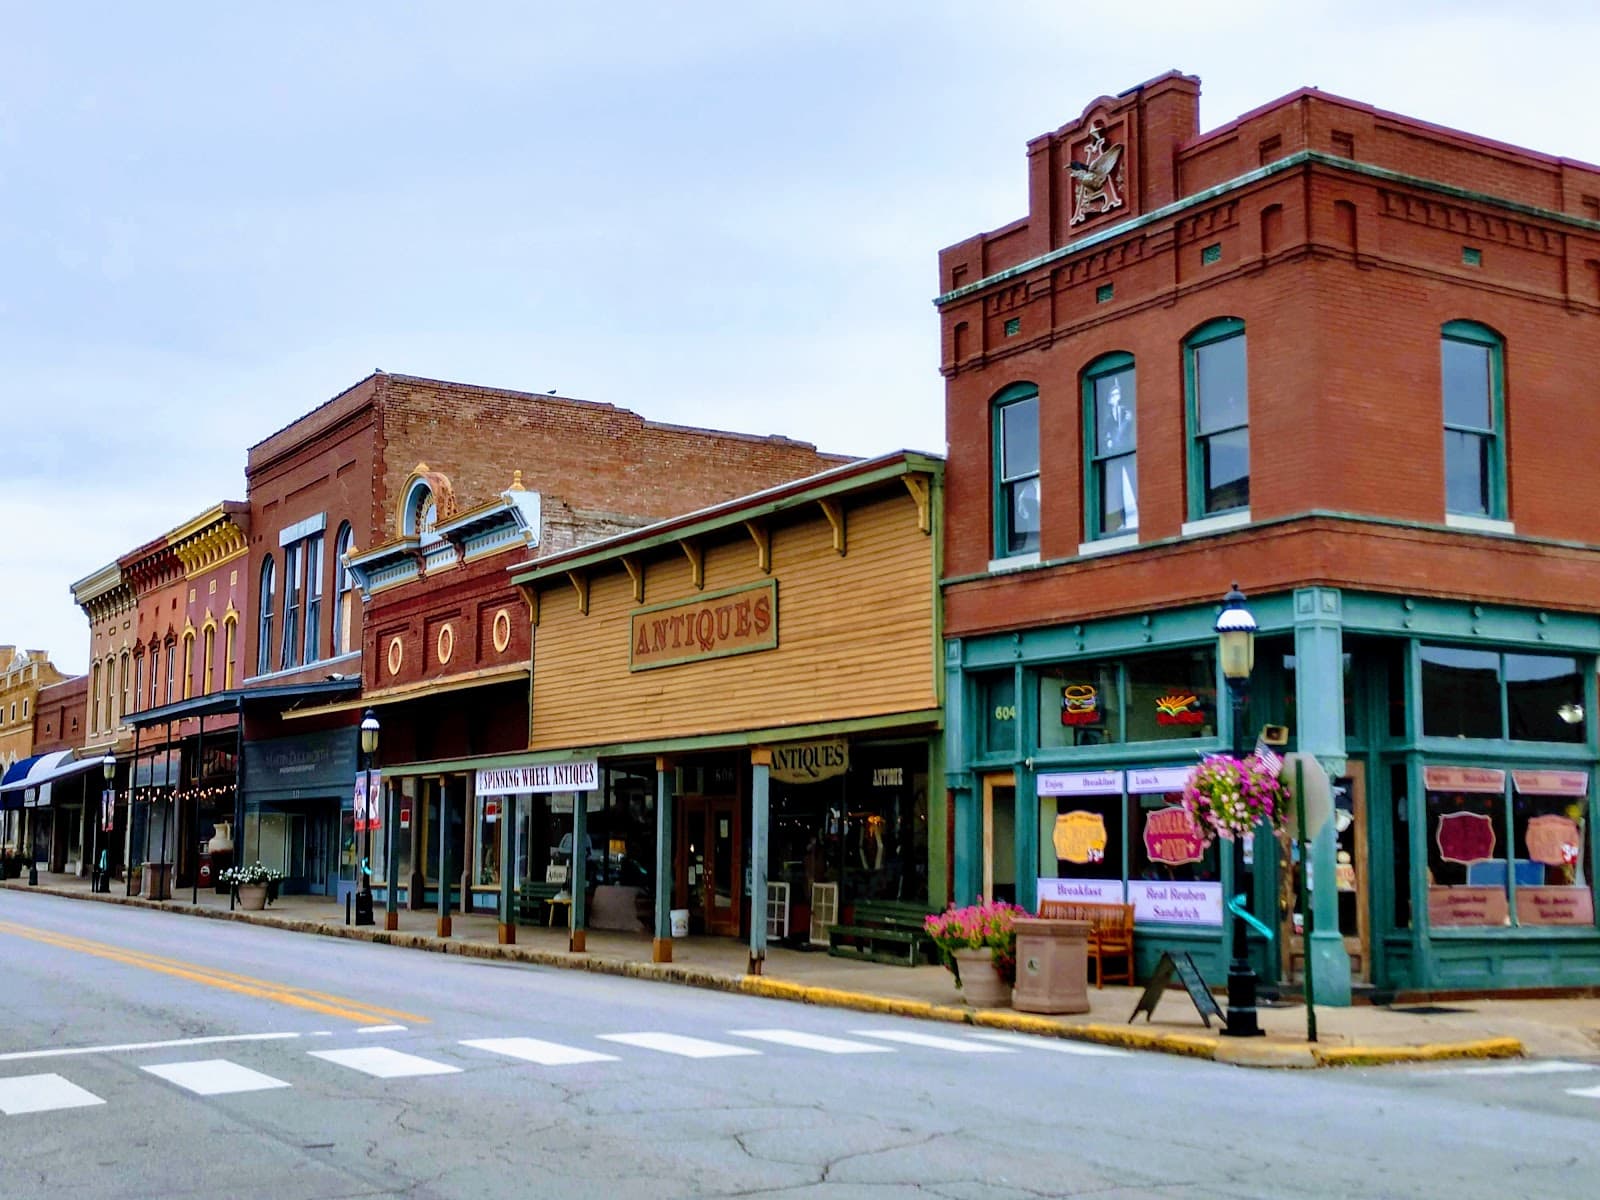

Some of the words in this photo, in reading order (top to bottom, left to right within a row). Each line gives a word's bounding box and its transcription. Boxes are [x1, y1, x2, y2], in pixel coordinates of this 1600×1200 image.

[635, 595, 772, 656] ANTIQUES
[995, 705, 1016, 721] 604
[770, 744, 844, 778] ANTIQUES
[484, 767, 519, 790] SPINNING
[521, 765, 551, 787] WHEEL
[553, 763, 594, 786] ANTIQUES
[1057, 882, 1103, 897] Breakfast
[1146, 886, 1168, 901] Real
[1152, 904, 1200, 919] Sandwich
